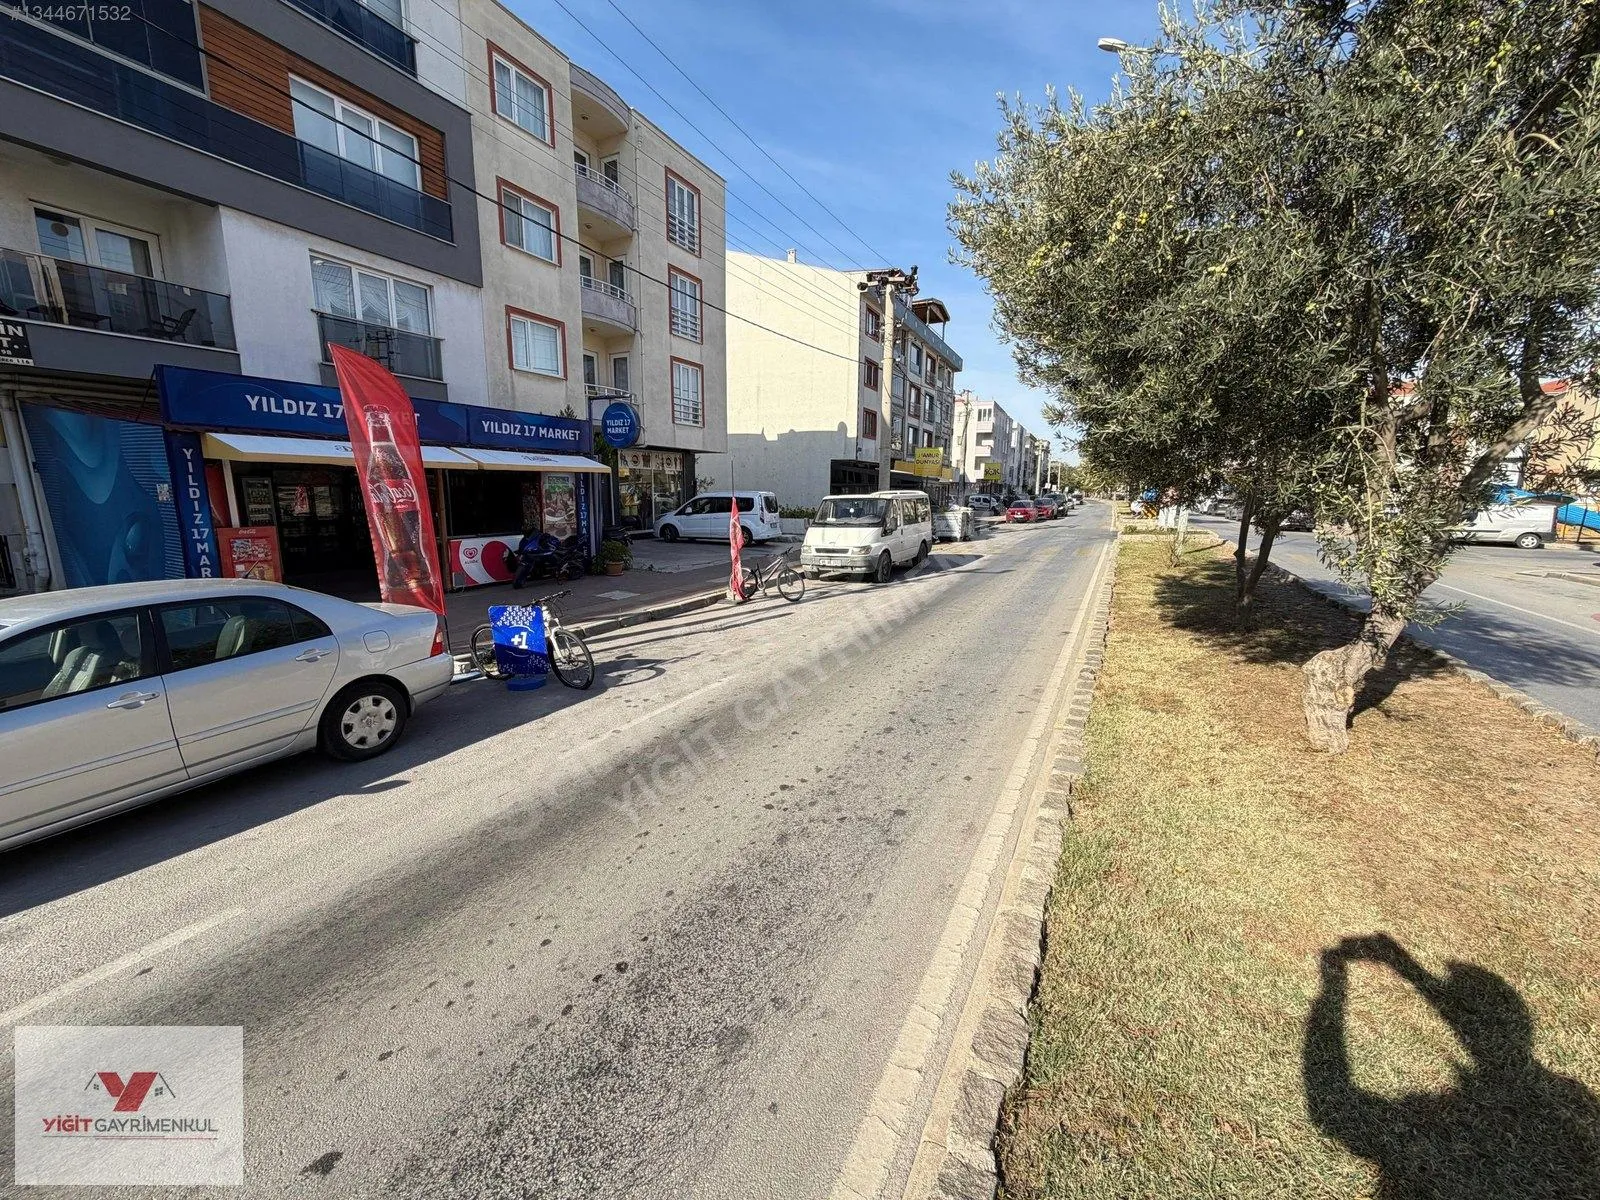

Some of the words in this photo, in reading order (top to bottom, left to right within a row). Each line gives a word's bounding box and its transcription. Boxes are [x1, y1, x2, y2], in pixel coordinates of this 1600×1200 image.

[245, 395, 317, 416] YILDIZ
[322, 403, 344, 419] 17
[482, 421, 521, 435] YILDIZ
[524, 425, 536, 437] 17
[539, 427, 580, 441] MARKET
[183, 448, 203, 524] YILDIZ
[191, 528, 209, 539] 17
[511, 632, 528, 649] +1
